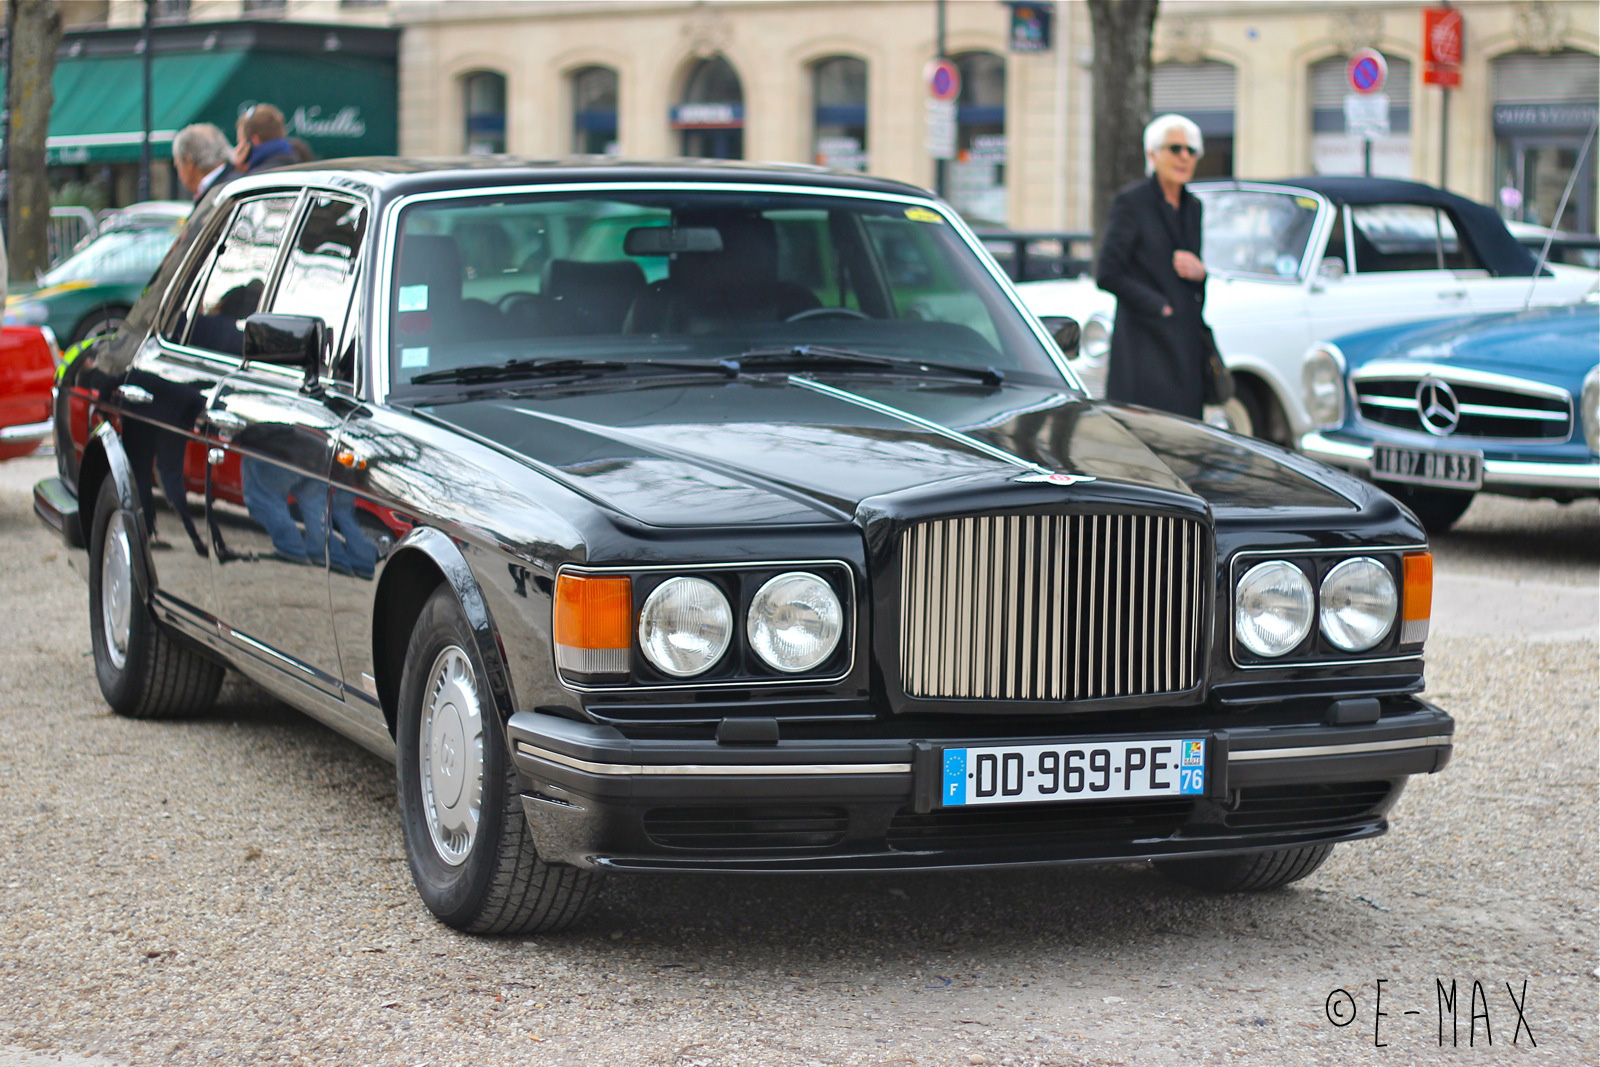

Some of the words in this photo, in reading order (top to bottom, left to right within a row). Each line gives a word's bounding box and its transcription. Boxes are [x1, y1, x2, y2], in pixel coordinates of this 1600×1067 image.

[1449, 454, 1471, 482] 33
[976, 746, 1172, 798] DD-969-PE
[1182, 769, 1203, 790] 76
[949, 783, 959, 796] F
